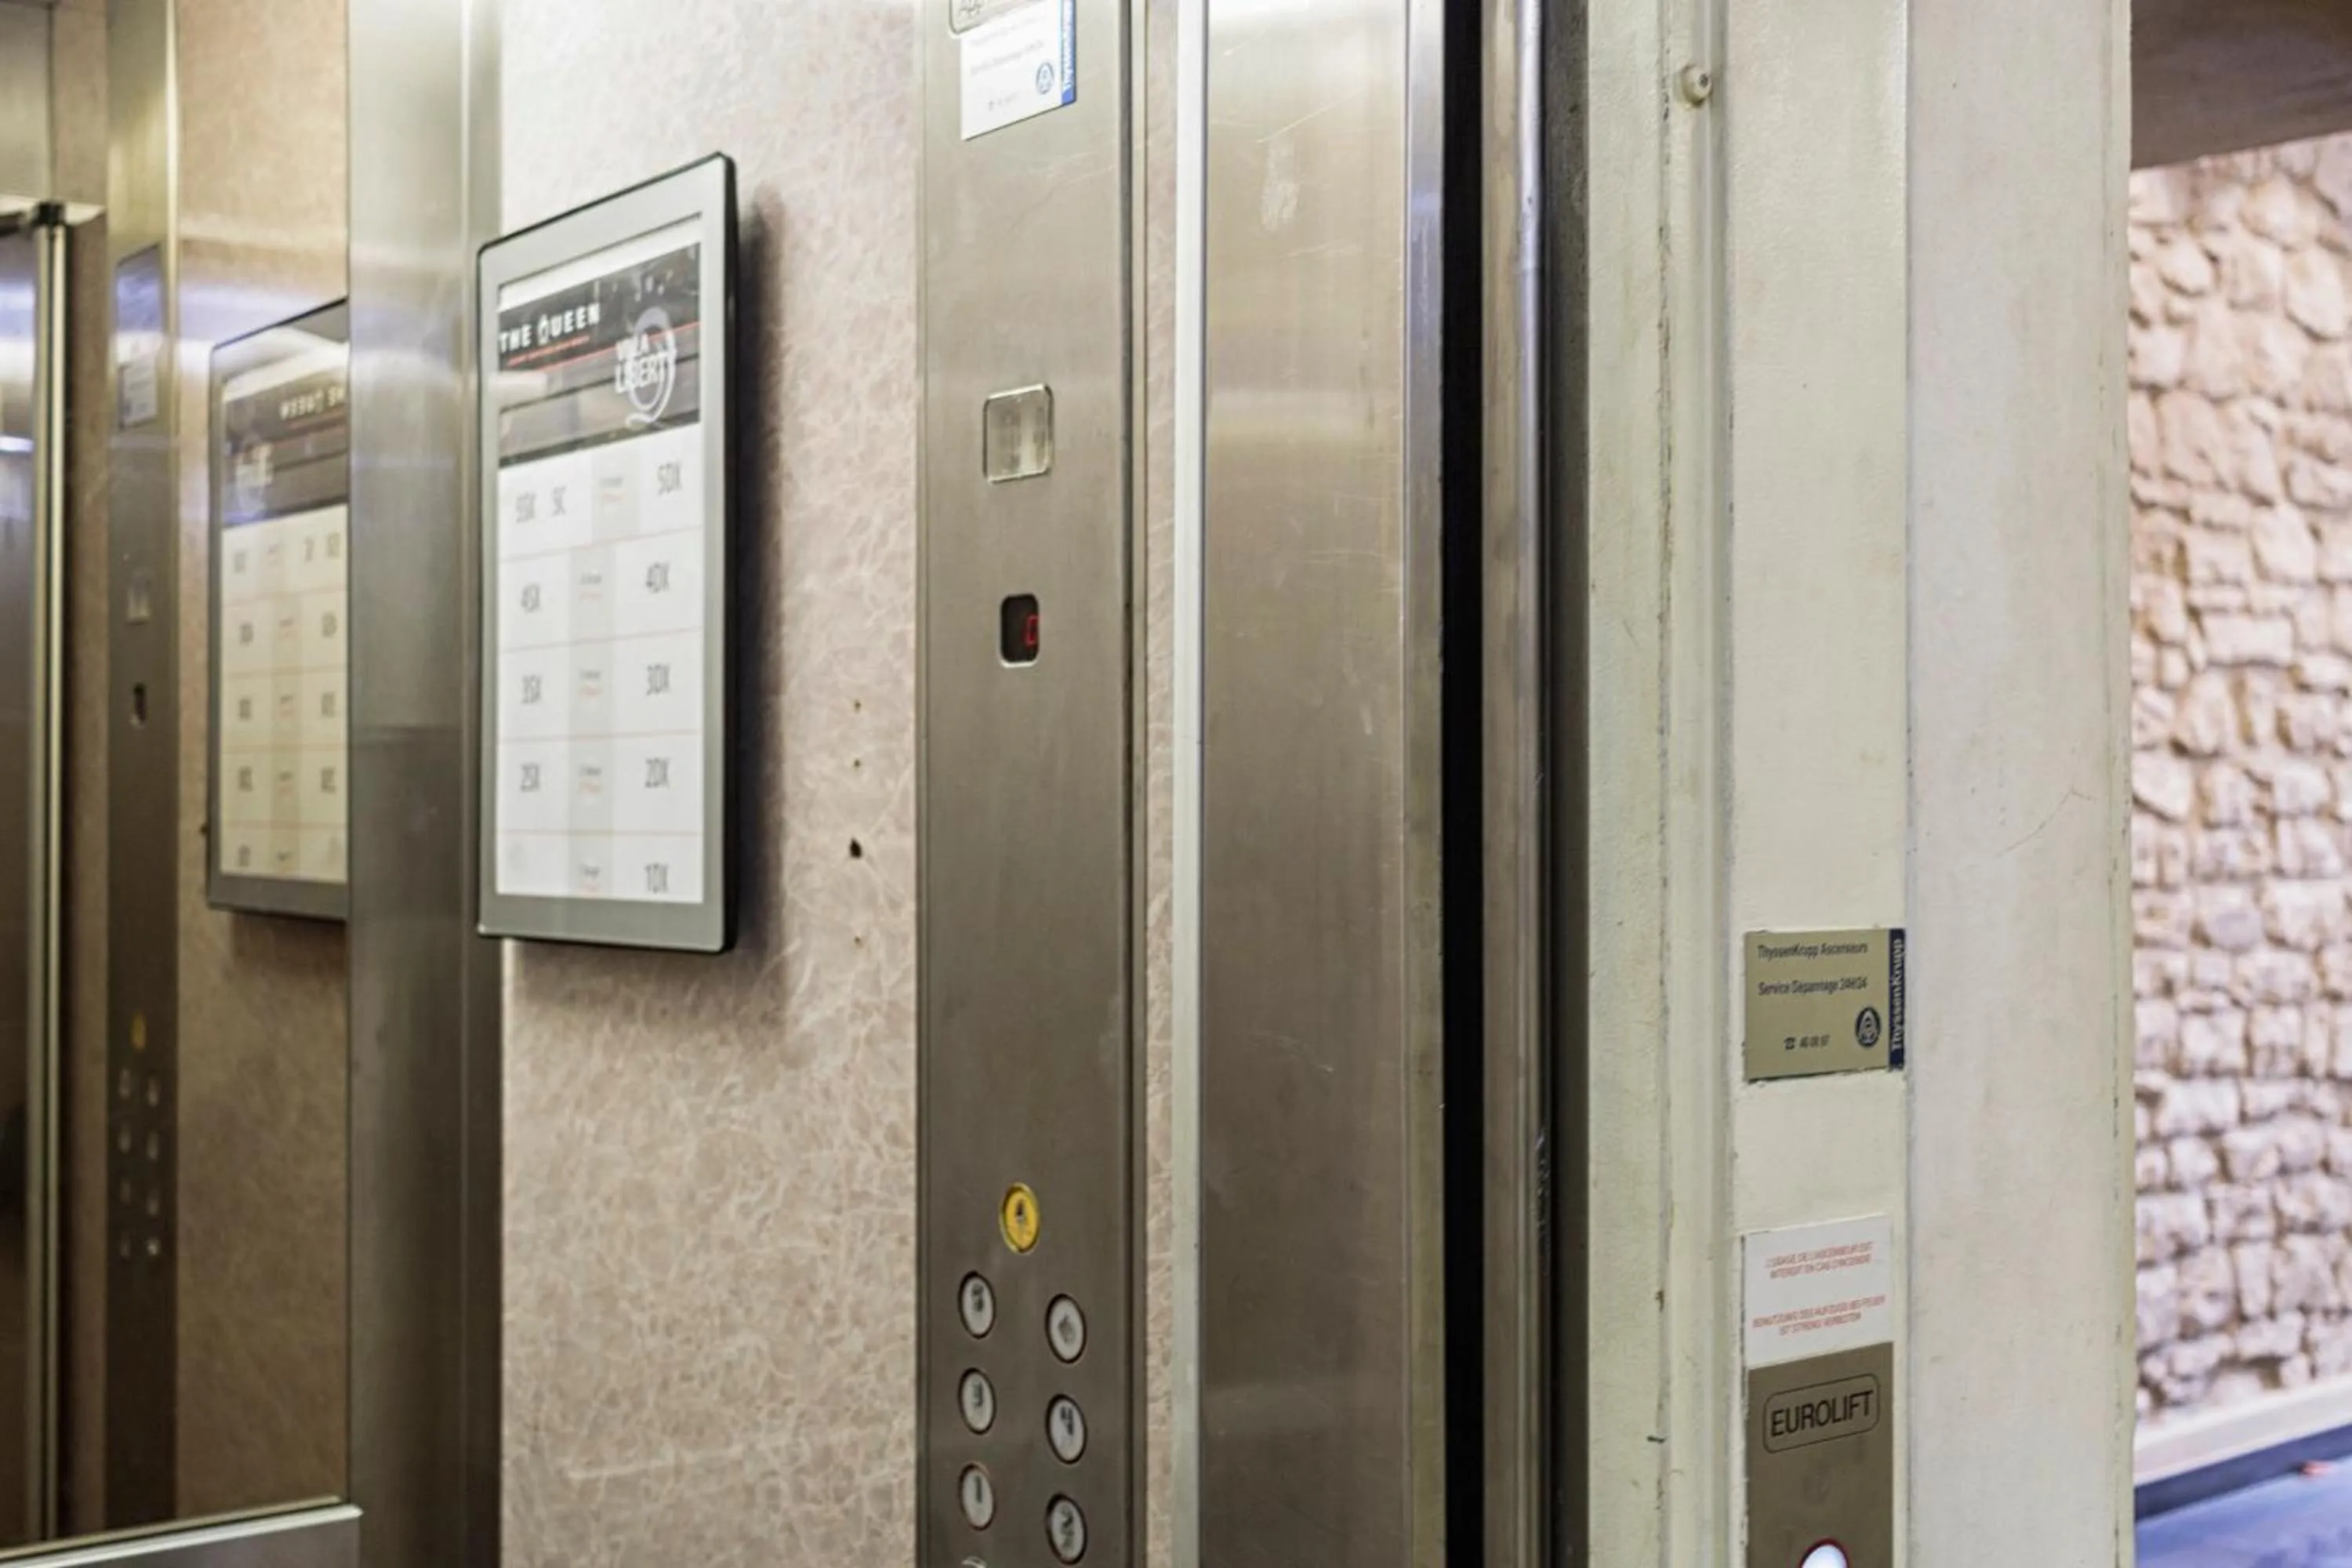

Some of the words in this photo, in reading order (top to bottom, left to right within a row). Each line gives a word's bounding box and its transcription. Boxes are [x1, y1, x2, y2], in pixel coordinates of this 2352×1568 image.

[499, 324, 532, 354] THE
[537, 302, 600, 346] QUEEN
[1770, 1389, 1874, 1438] EUROLIFT
